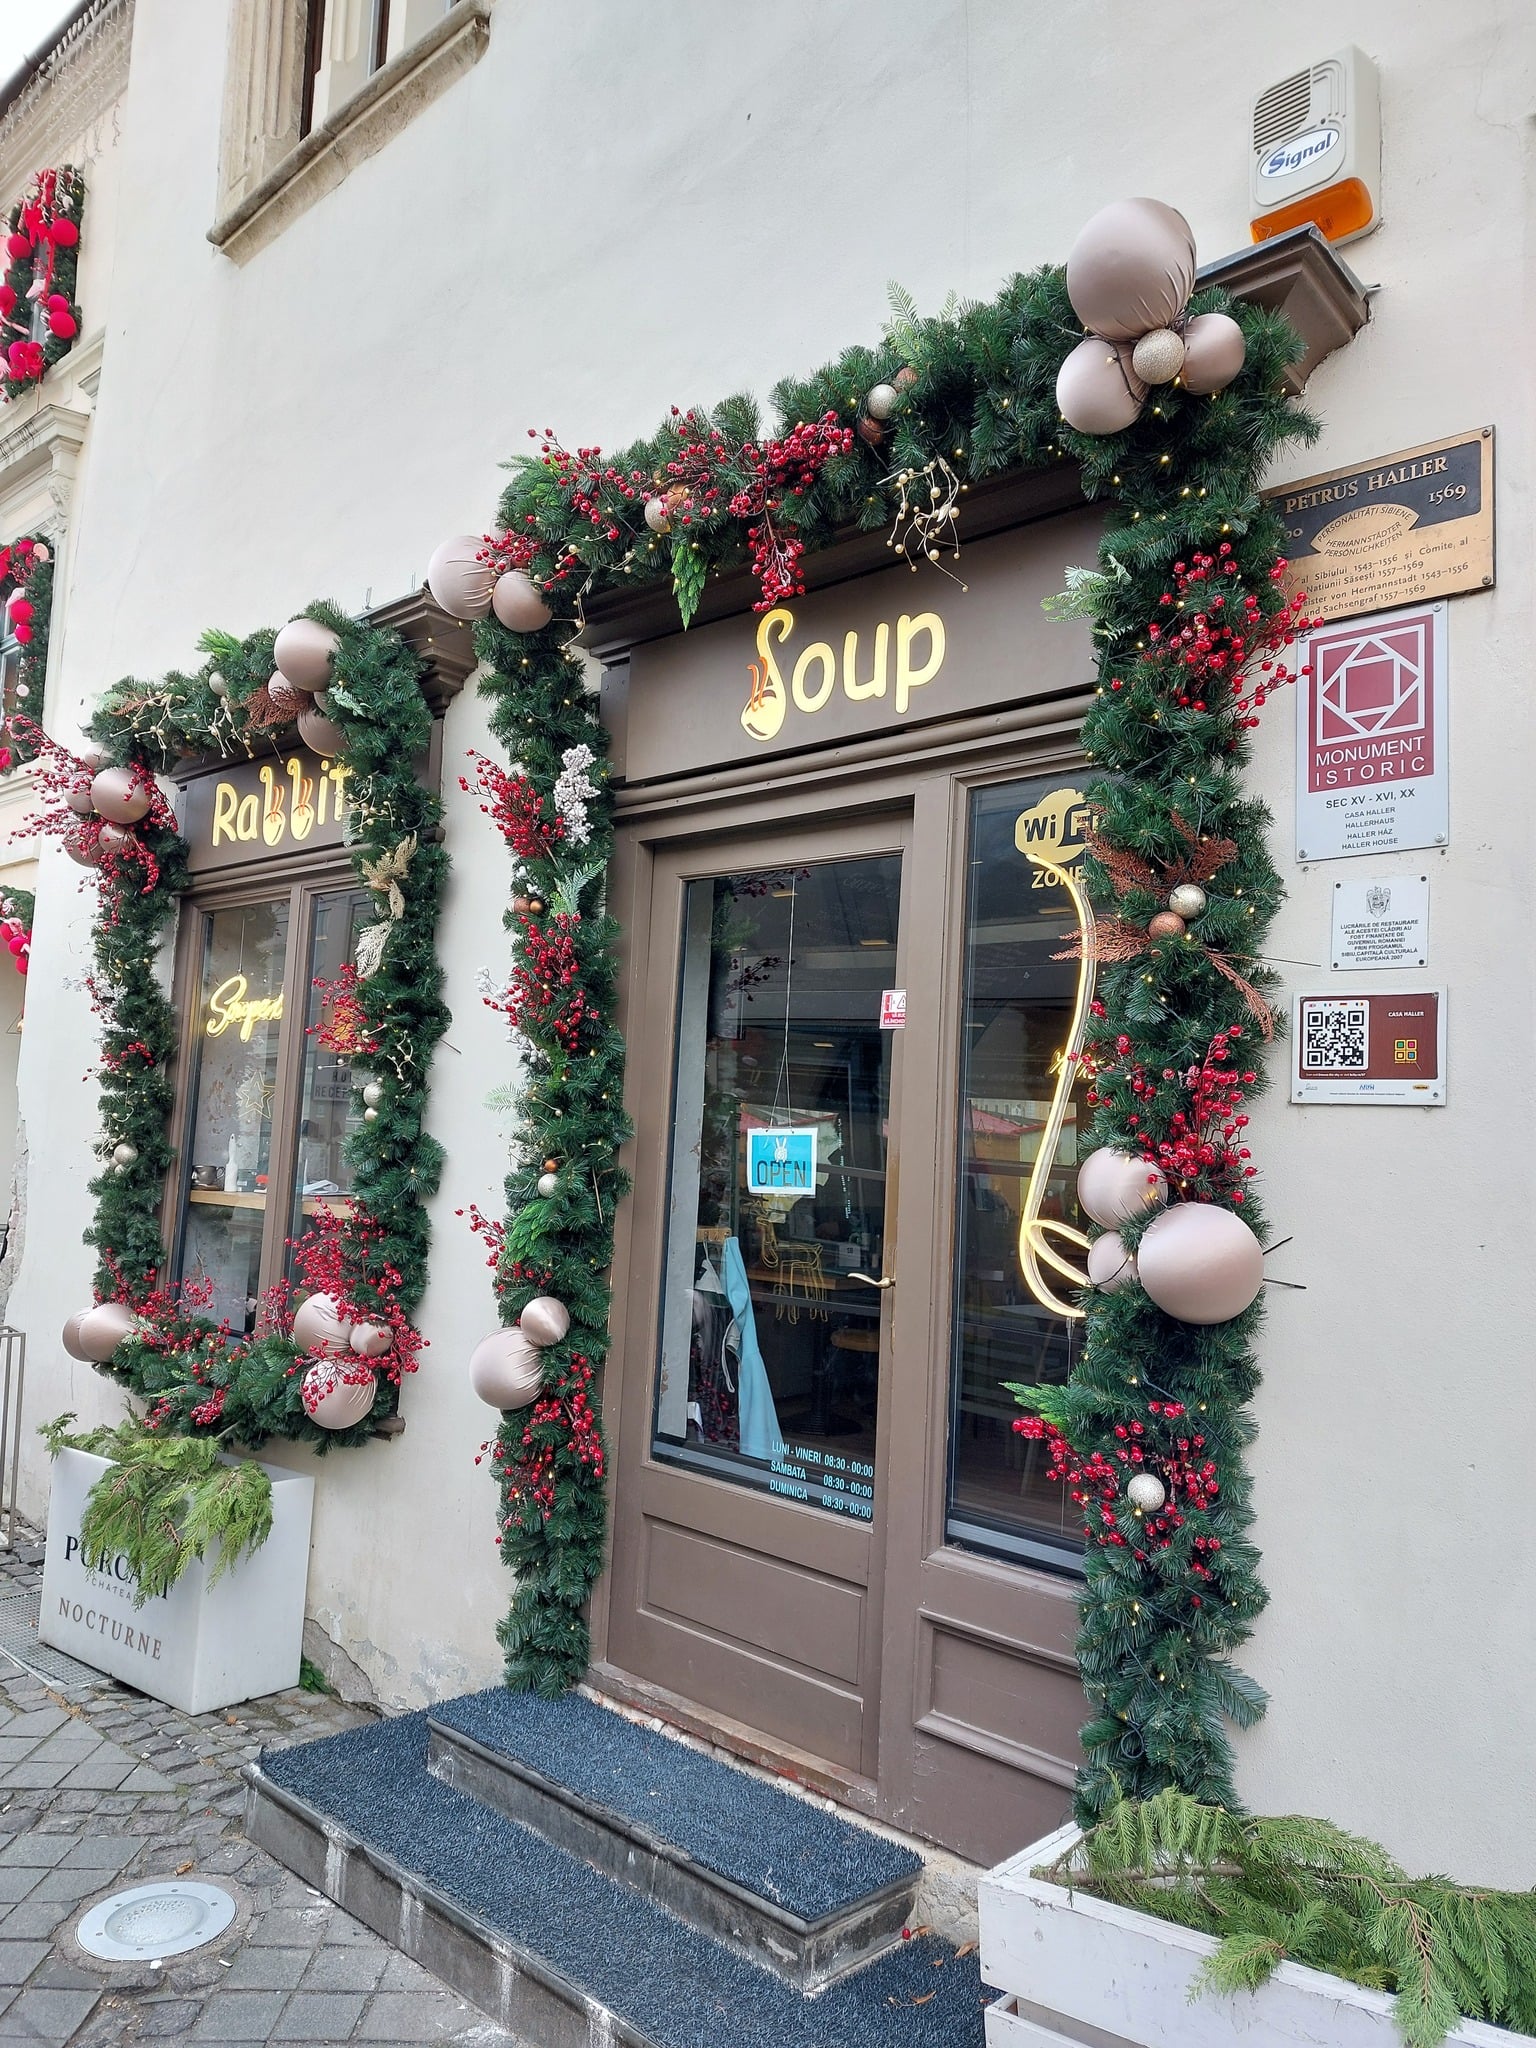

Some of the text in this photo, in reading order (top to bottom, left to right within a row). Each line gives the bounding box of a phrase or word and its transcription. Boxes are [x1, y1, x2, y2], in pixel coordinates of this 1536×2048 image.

[1268, 132, 1332, 175] Signal
[1285, 456, 1448, 513] PETRUS HALLER
[1428, 483, 1467, 506] 1569
[1380, 506, 1412, 521] SIBIENE
[1314, 566, 1348, 581] Sibiului
[1460, 536, 1468, 546] al
[1331, 592, 1347, 601] von
[1351, 573, 1417, 596] Hermannstadt
[1304, 606, 1321, 618] und
[1323, 594, 1379, 614] Sachsengraf
[741, 608, 946, 741] Soup
[1316, 735, 1426, 767] MONUMENT
[1316, 756, 1425, 787] ISTORIC
[212, 758, 352, 847] Rabbit
[1326, 798, 1348, 809] SEC
[1350, 795, 1366, 806] XV
[1400, 788, 1415, 799] XX
[1344, 806, 1396, 819] CASA HALLER
[1345, 817, 1395, 829] HALLERHAUS
[1347, 830, 1376, 840] HALLER
[1341, 837, 1399, 850] HALLER HOUSE
[1380, 919, 1418, 927] RESTAURARE
[757, 1160, 806, 1187] OPEN
[772, 1440, 790, 1455] LUNI
[795, 1446, 821, 1464] VINERI
[824, 1454, 846, 1470] 08:30
[851, 1461, 873, 1478] 00:00
[770, 1460, 806, 1480] SAMBATA
[823, 1474, 845, 1491] 08:30
[850, 1482, 872, 1498] 00:00
[769, 1479, 808, 1500] DUMINICA
[822, 1494, 844, 1511] 08:30
[849, 1502, 871, 1518] 00:00
[91, 1577, 132, 1601] CHATEA
[58, 1597, 162, 1661] NOCTURNE
